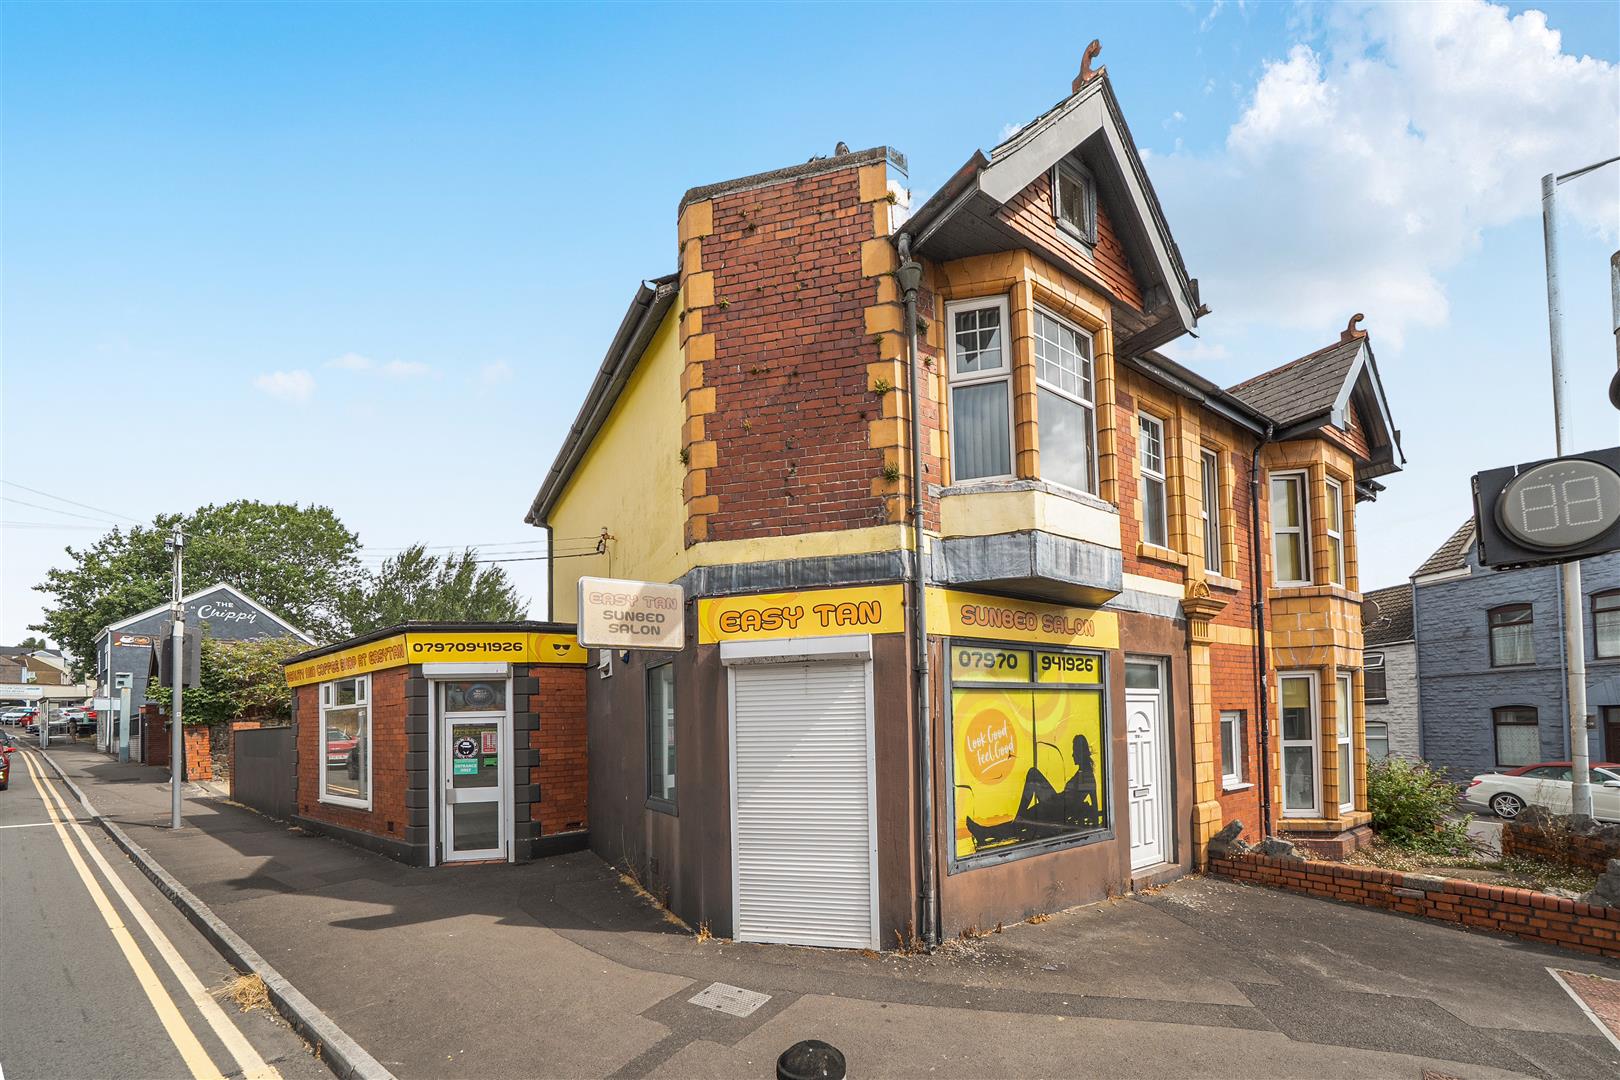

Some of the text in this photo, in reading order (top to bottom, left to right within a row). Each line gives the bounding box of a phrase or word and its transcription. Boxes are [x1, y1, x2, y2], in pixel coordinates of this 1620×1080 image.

[589, 591, 678, 610] EASY TAN
[603, 610, 665, 624] SUNBED
[719, 600, 882, 633] EASY TAN
[960, 604, 1096, 638] SUNBED SALON
[608, 623, 661, 636] SALON
[316, 659, 340, 676] COFFEE
[340, 655, 357, 671] SHOP
[357, 653, 368, 667] AT
[368, 644, 405, 665] EASYTAN
[413, 642, 523, 653] 07970941926
[959, 651, 1094, 672] 07970 941926
[966, 719, 1008, 753] Look Good
[977, 737, 1015, 766] Feel Good
